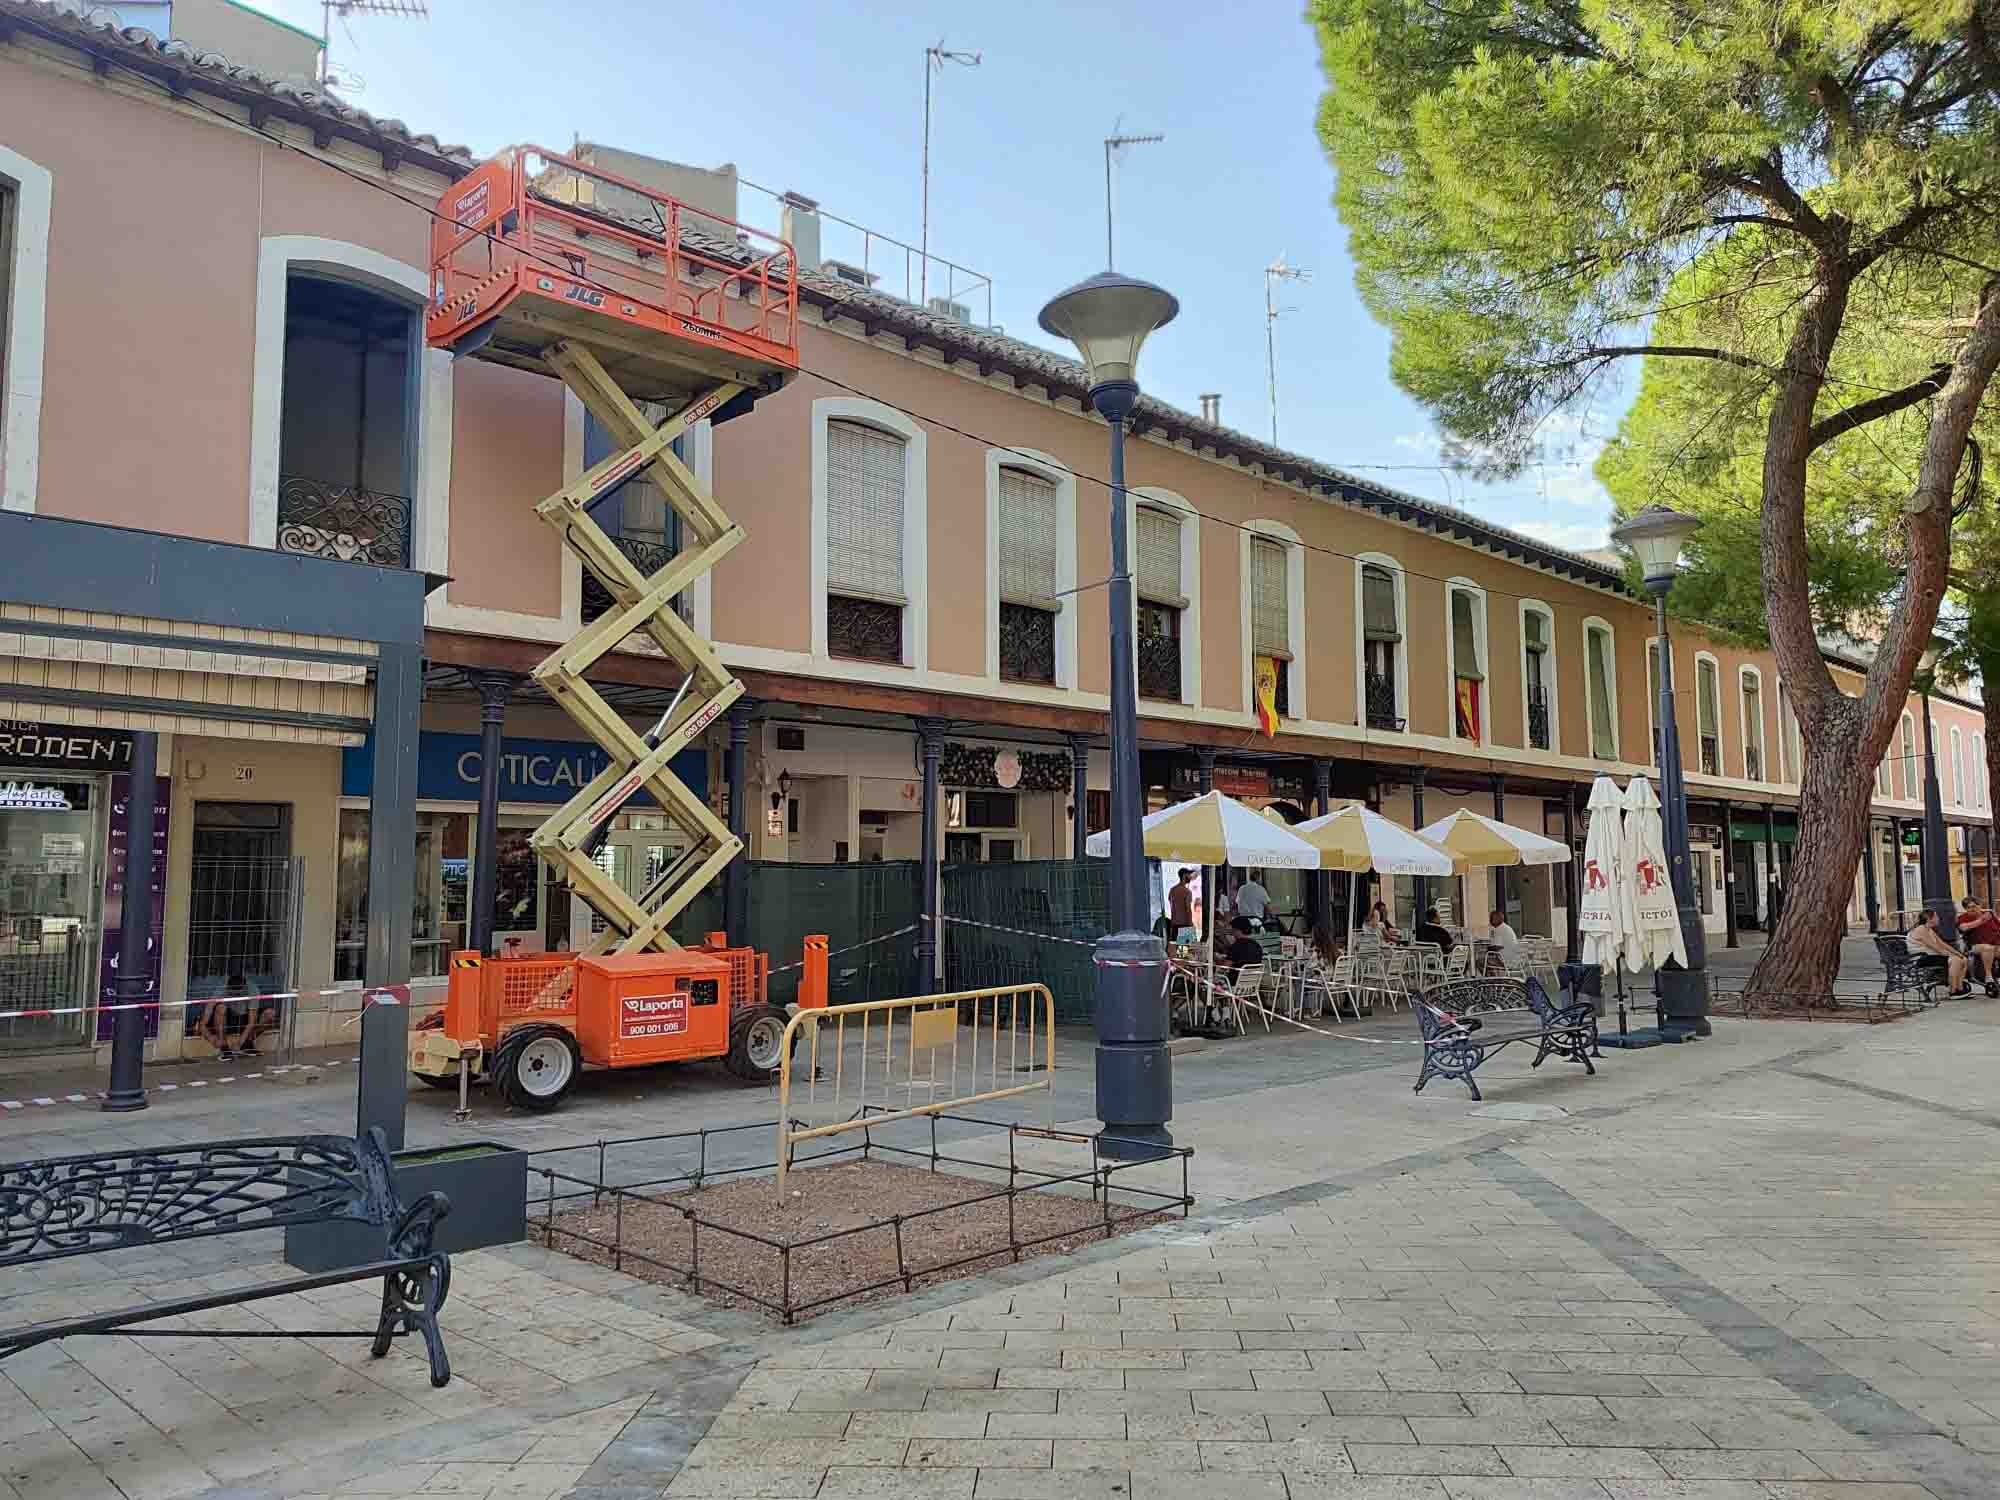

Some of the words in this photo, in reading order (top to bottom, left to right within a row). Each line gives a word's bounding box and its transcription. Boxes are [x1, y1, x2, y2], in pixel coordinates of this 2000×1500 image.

[564, 287, 604, 306] JLG
[235, 767, 252, 780] 20
[640, 997, 684, 1014] Laporta
[630, 1025, 645, 1035] 900
[647, 1024, 661, 1033] 001
